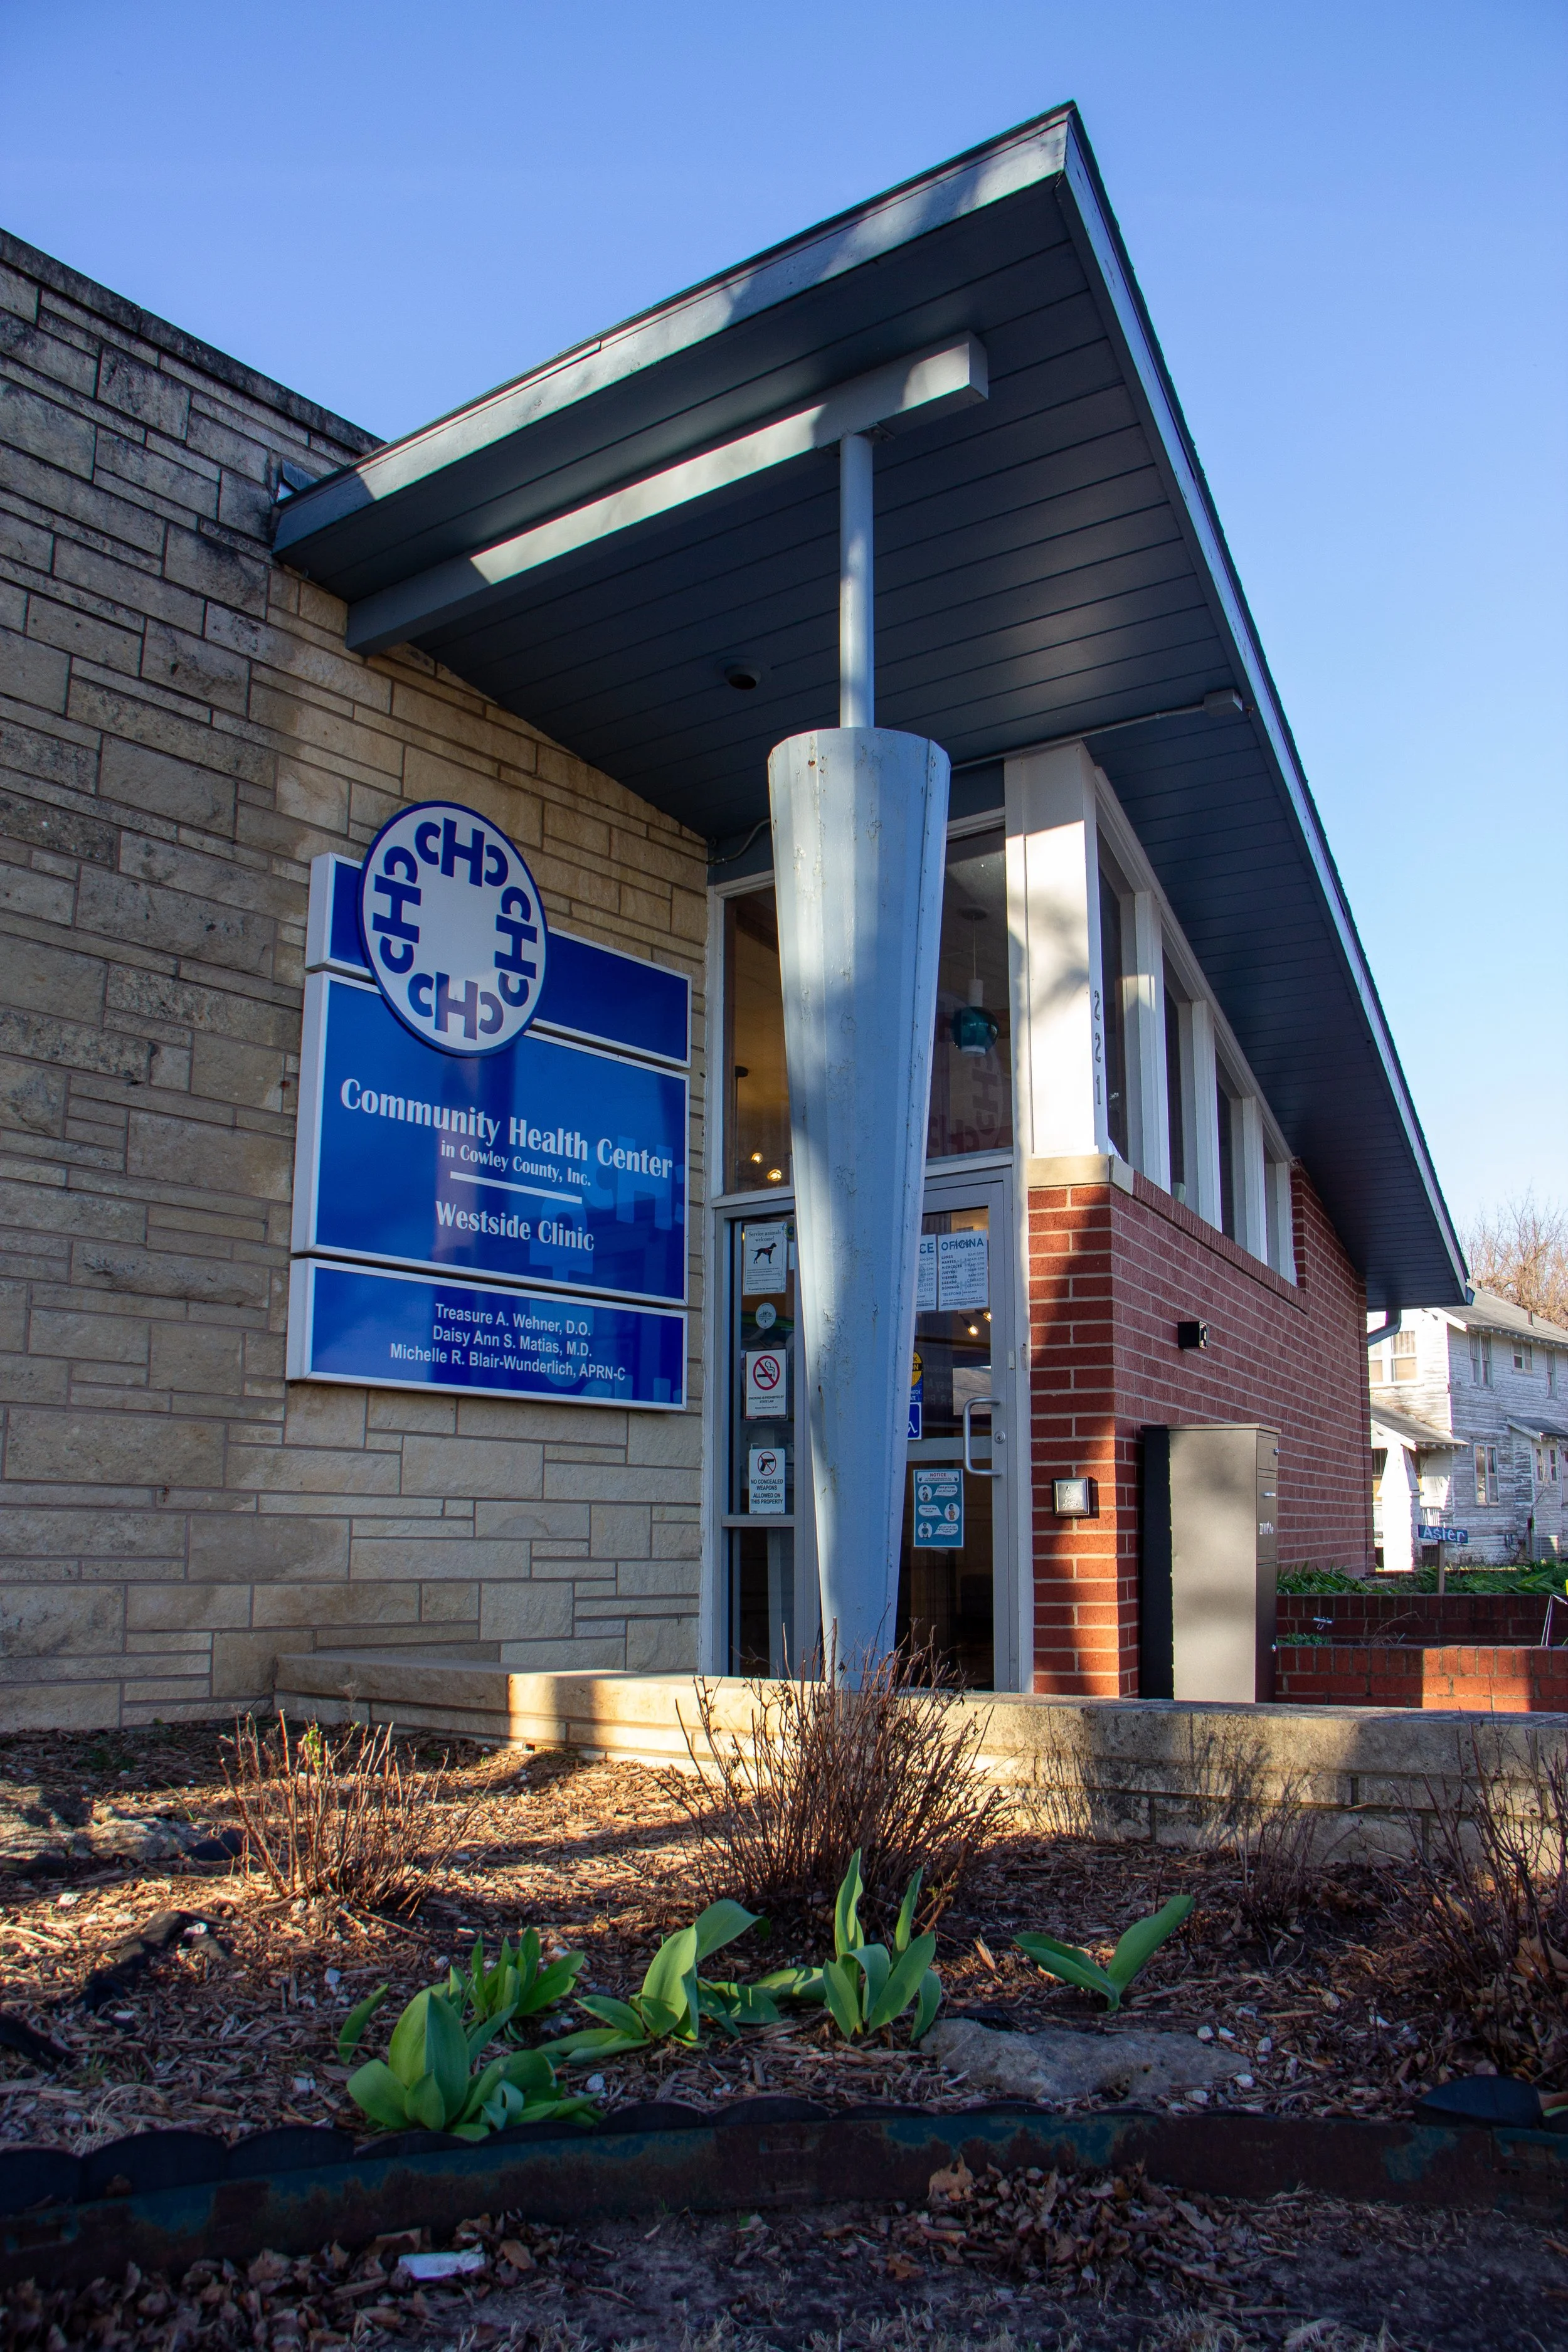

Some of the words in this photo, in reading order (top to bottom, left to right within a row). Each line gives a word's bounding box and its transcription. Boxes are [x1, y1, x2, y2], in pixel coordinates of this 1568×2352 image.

[341, 1078, 501, 1147] Community
[509, 1116, 588, 1161] Health
[597, 1138, 673, 1179] Center
[441, 1140, 455, 1158] in
[460, 1144, 509, 1172] Cowley
[513, 1156, 563, 1183] County,
[568, 1167, 591, 1186] Inc.
[436, 1200, 531, 1240] Westside
[538, 1221, 594, 1251] Clinic
[919, 1242, 935, 1254] CE
[941, 1237, 984, 1251] OFICINA
[435, 1303, 493, 1324] Treasure
[495, 1311, 509, 1327] A.
[513, 1313, 562, 1335] Wehner,
[566, 1320, 591, 1336] D.O.
[433, 1325, 470, 1347] Daisy
[473, 1330, 500, 1347] Ann
[504, 1333, 516, 1348] S.
[520, 1335, 563, 1356] Matias,
[566, 1341, 592, 1357] M.D.
[390, 1343, 448, 1364] Michelle
[451, 1350, 465, 1365] R.
[469, 1352, 576, 1378] Blair-Wunderlich,
[579, 1364, 625, 1380] APRN-C
